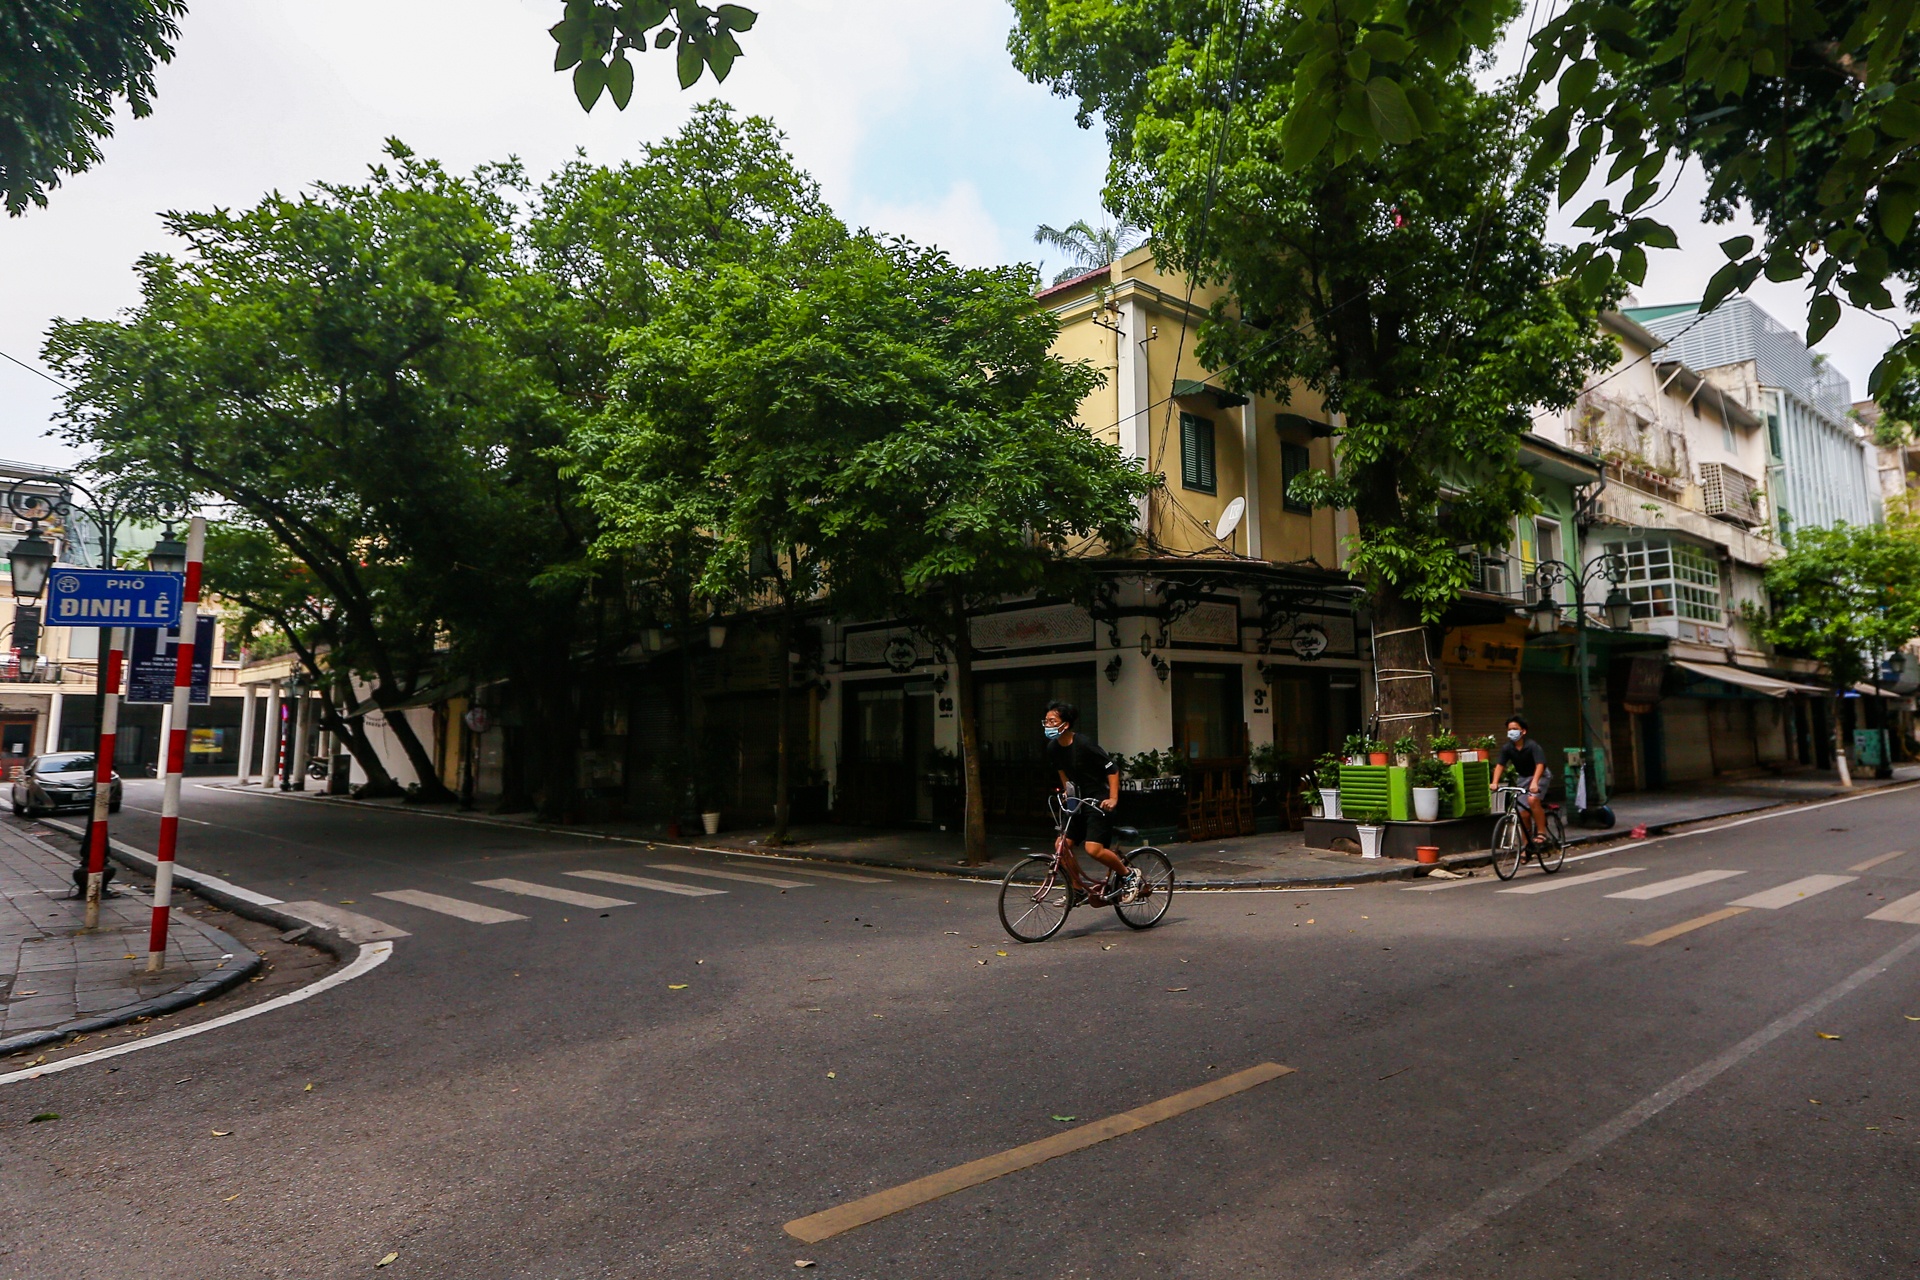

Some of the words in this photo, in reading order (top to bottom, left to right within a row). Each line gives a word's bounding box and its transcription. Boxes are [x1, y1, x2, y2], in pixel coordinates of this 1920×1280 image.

[107, 577, 145, 590] PHỐ
[60, 599, 131, 617] ĐINH
[138, 592, 170, 618] LỄ
